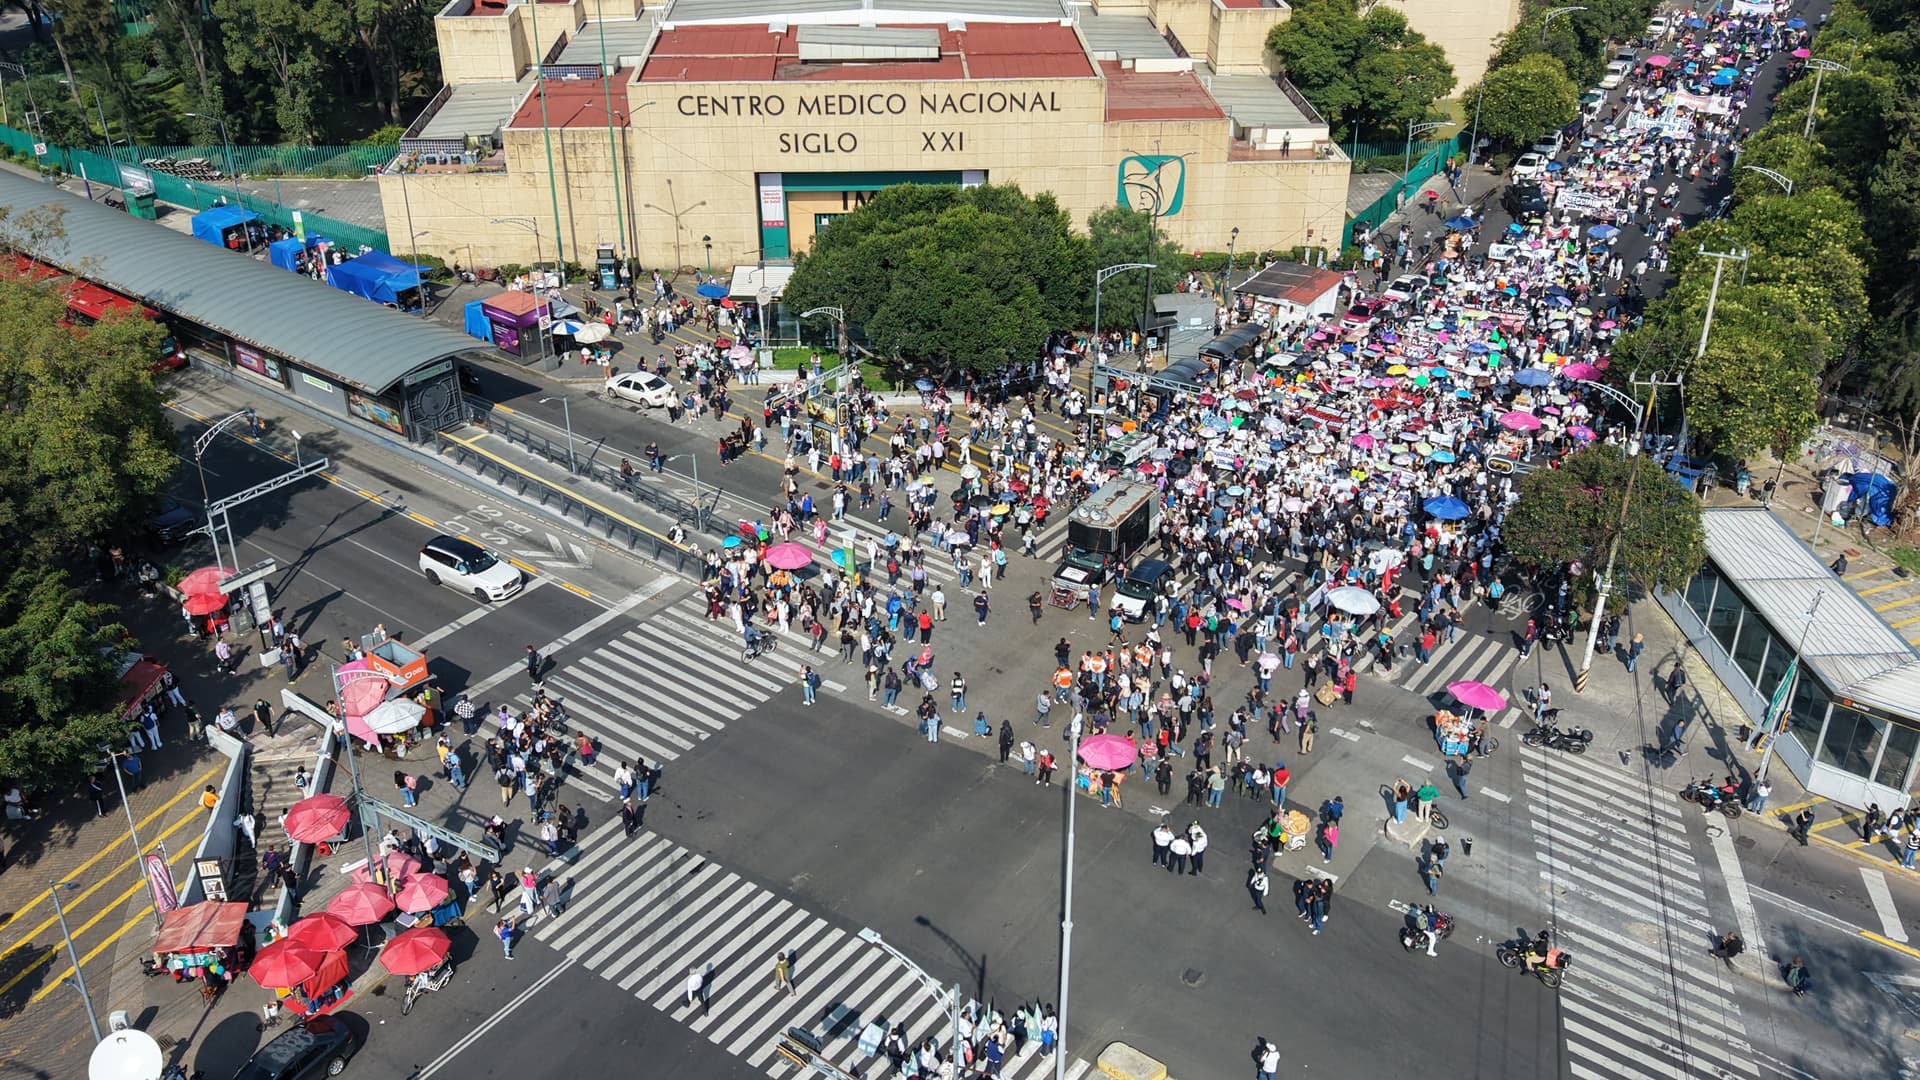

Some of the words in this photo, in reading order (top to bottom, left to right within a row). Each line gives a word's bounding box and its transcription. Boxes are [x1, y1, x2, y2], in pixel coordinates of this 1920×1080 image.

[677, 94, 785, 117] CENTRO
[797, 93, 907, 115] MEDICO
[920, 91, 1062, 115] NACIONAL
[779, 132, 858, 153] SIGLO
[922, 131, 964, 152] XXI
